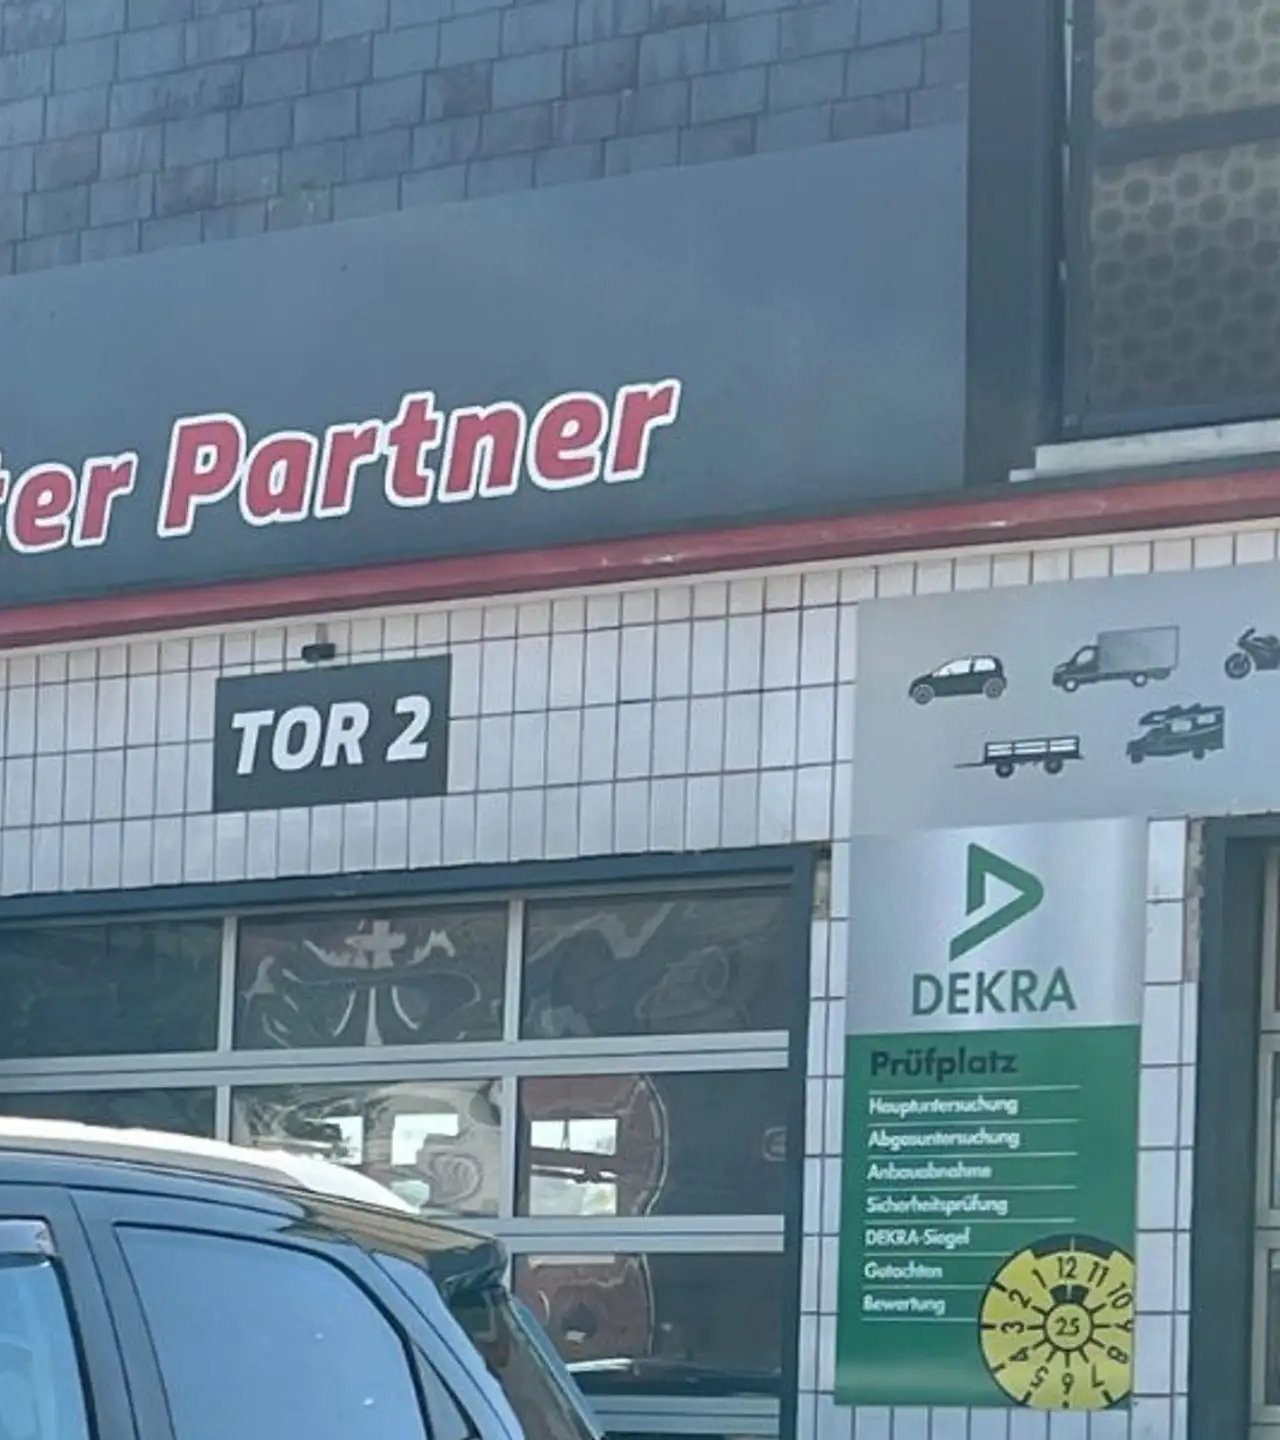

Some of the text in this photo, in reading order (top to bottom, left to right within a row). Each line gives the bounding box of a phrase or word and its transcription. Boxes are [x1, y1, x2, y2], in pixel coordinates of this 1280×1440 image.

[157, 378, 681, 537] Partner
[231, 695, 432, 776] TOR 2
[912, 965, 1077, 1016] DEKRA
[870, 1047, 1018, 1082] Prüfplatz
[868, 1095, 1019, 1119] Hauptuntersuchung
[867, 1127, 1021, 1151] Abgasuntersuchung
[866, 1161, 993, 1181] Anbauabnahme
[865, 1193, 1009, 1217] Sicherheitsprüfung
[864, 1226, 972, 1249] DEKRA-Siegel
[864, 1260, 944, 1279] Gutachten
[1057, 1255, 1078, 1280] 12
[862, 1294, 947, 1316] Bewertung
[1054, 1316, 1081, 1337] 25
